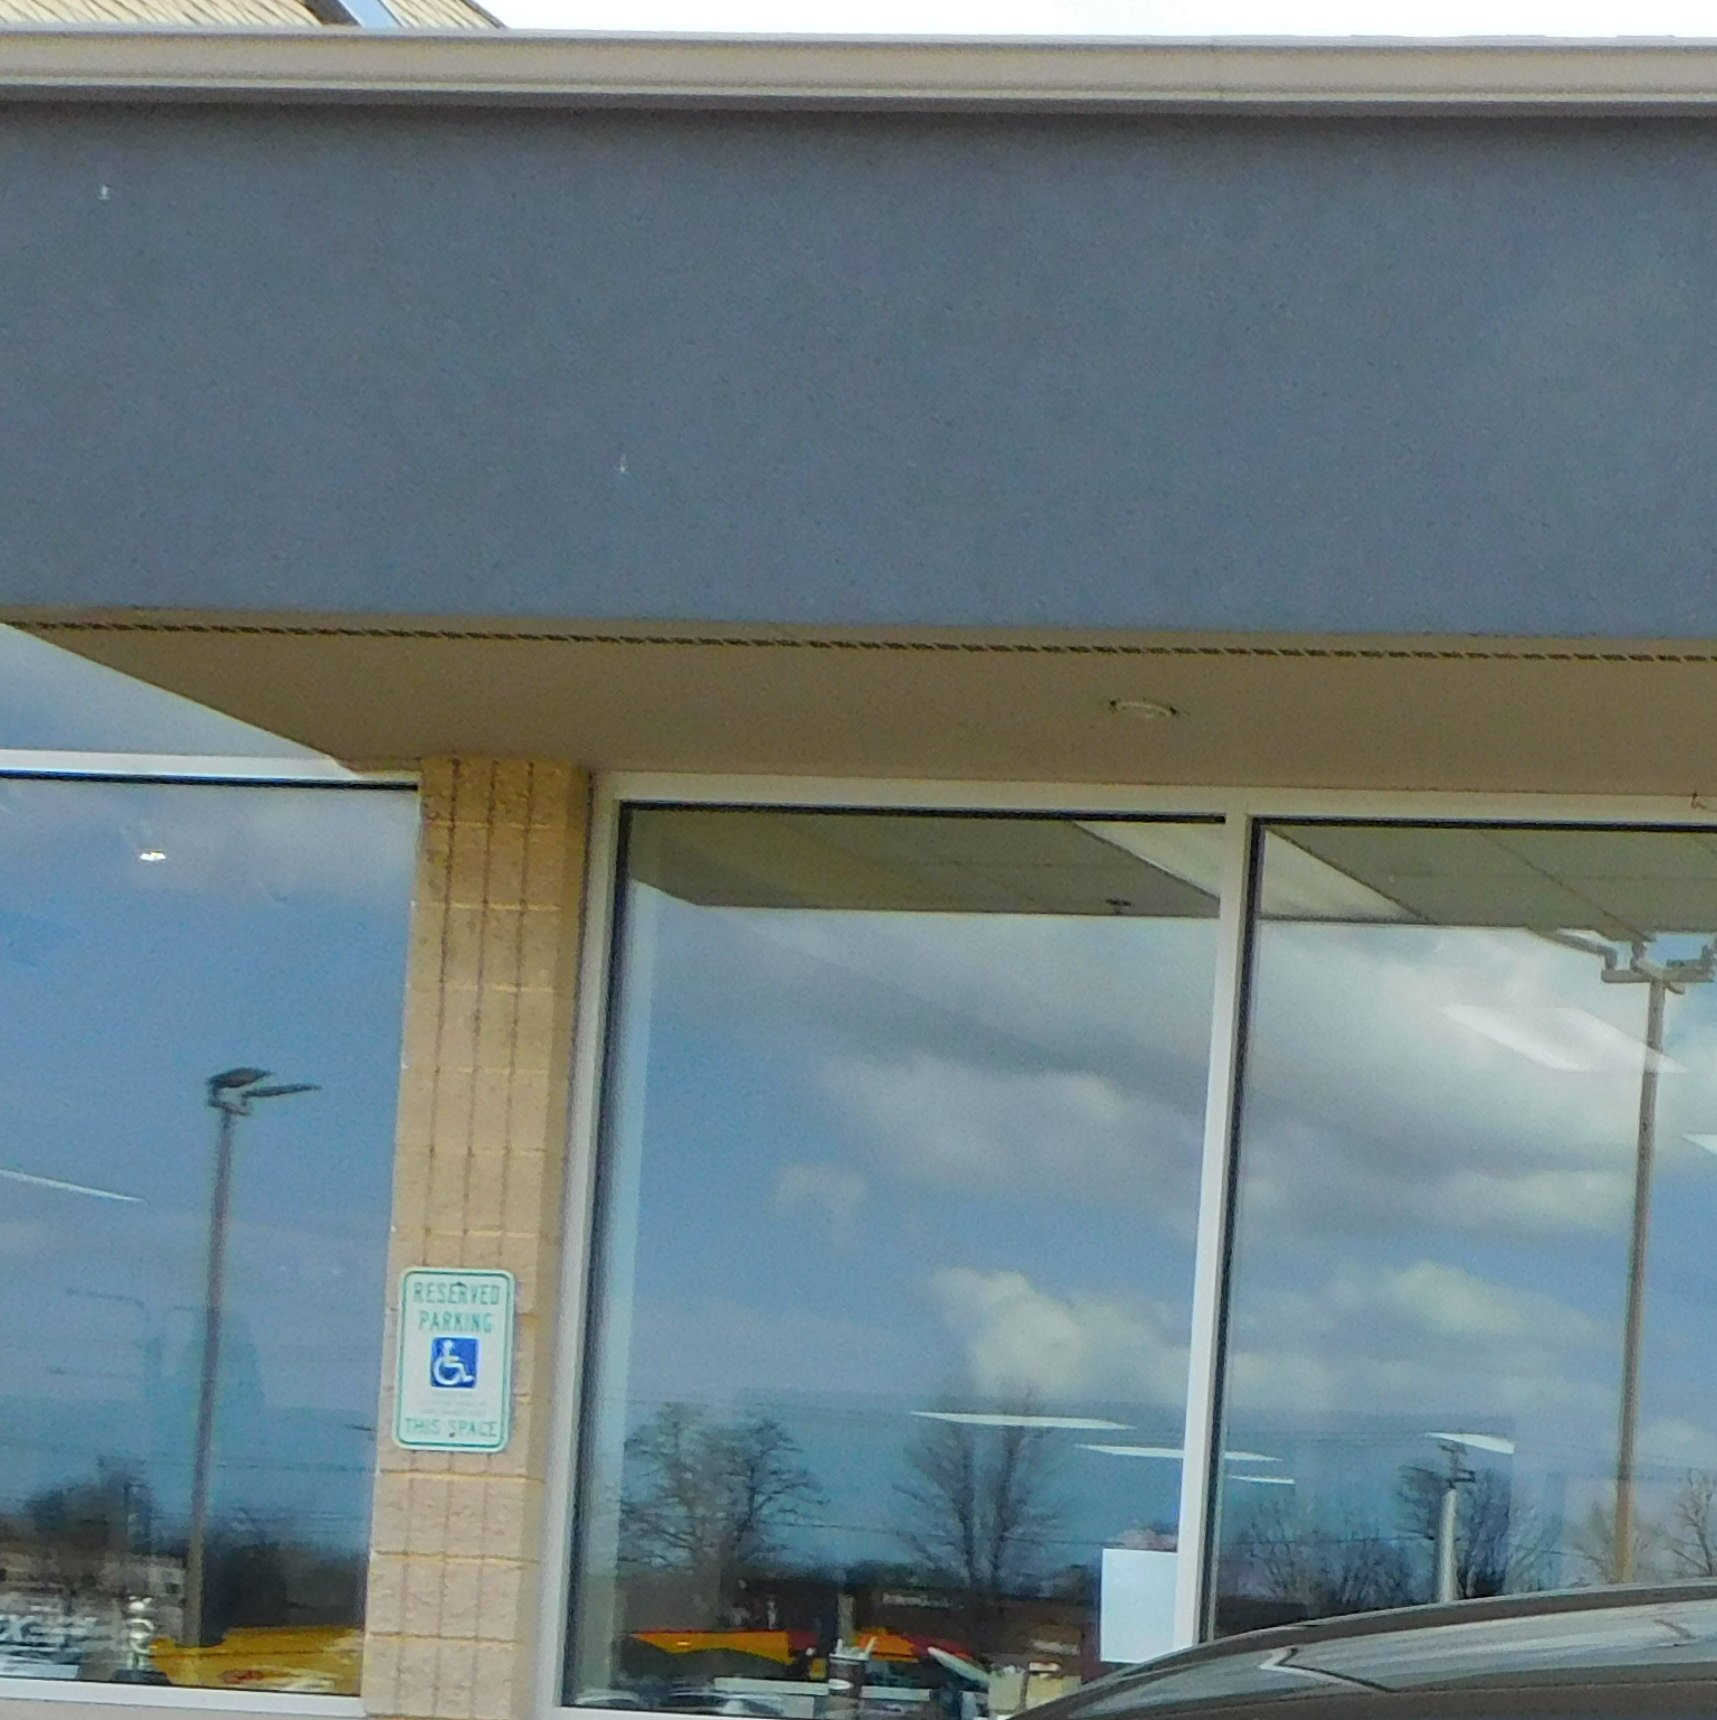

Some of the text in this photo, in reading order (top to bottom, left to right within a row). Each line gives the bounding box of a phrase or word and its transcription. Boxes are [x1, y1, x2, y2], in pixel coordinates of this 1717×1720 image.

[413, 1281, 500, 1305] RESERVED
[418, 1311, 494, 1333] PARKING
[404, 1417, 498, 1438] THIS SPACE
